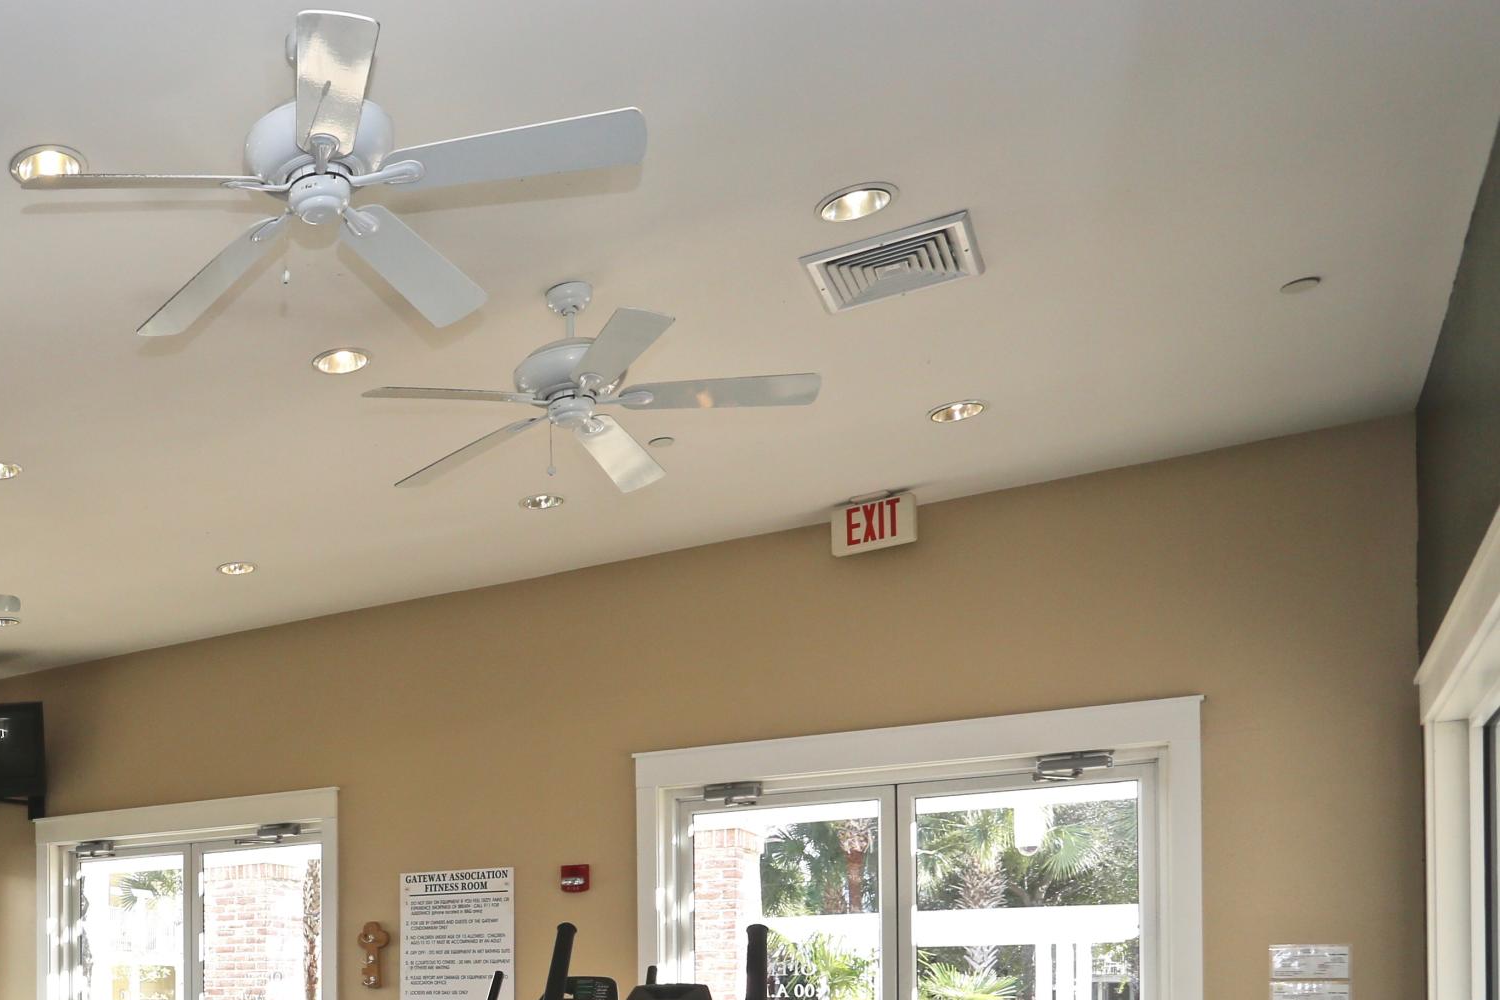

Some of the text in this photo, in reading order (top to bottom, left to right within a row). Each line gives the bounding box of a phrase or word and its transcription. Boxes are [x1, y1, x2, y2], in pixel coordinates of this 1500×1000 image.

[846, 497, 900, 546] EXIT
[405, 870, 509, 884] GATEWAY ASSOCIATION
[424, 881, 488, 892] FITNESS ROOM
